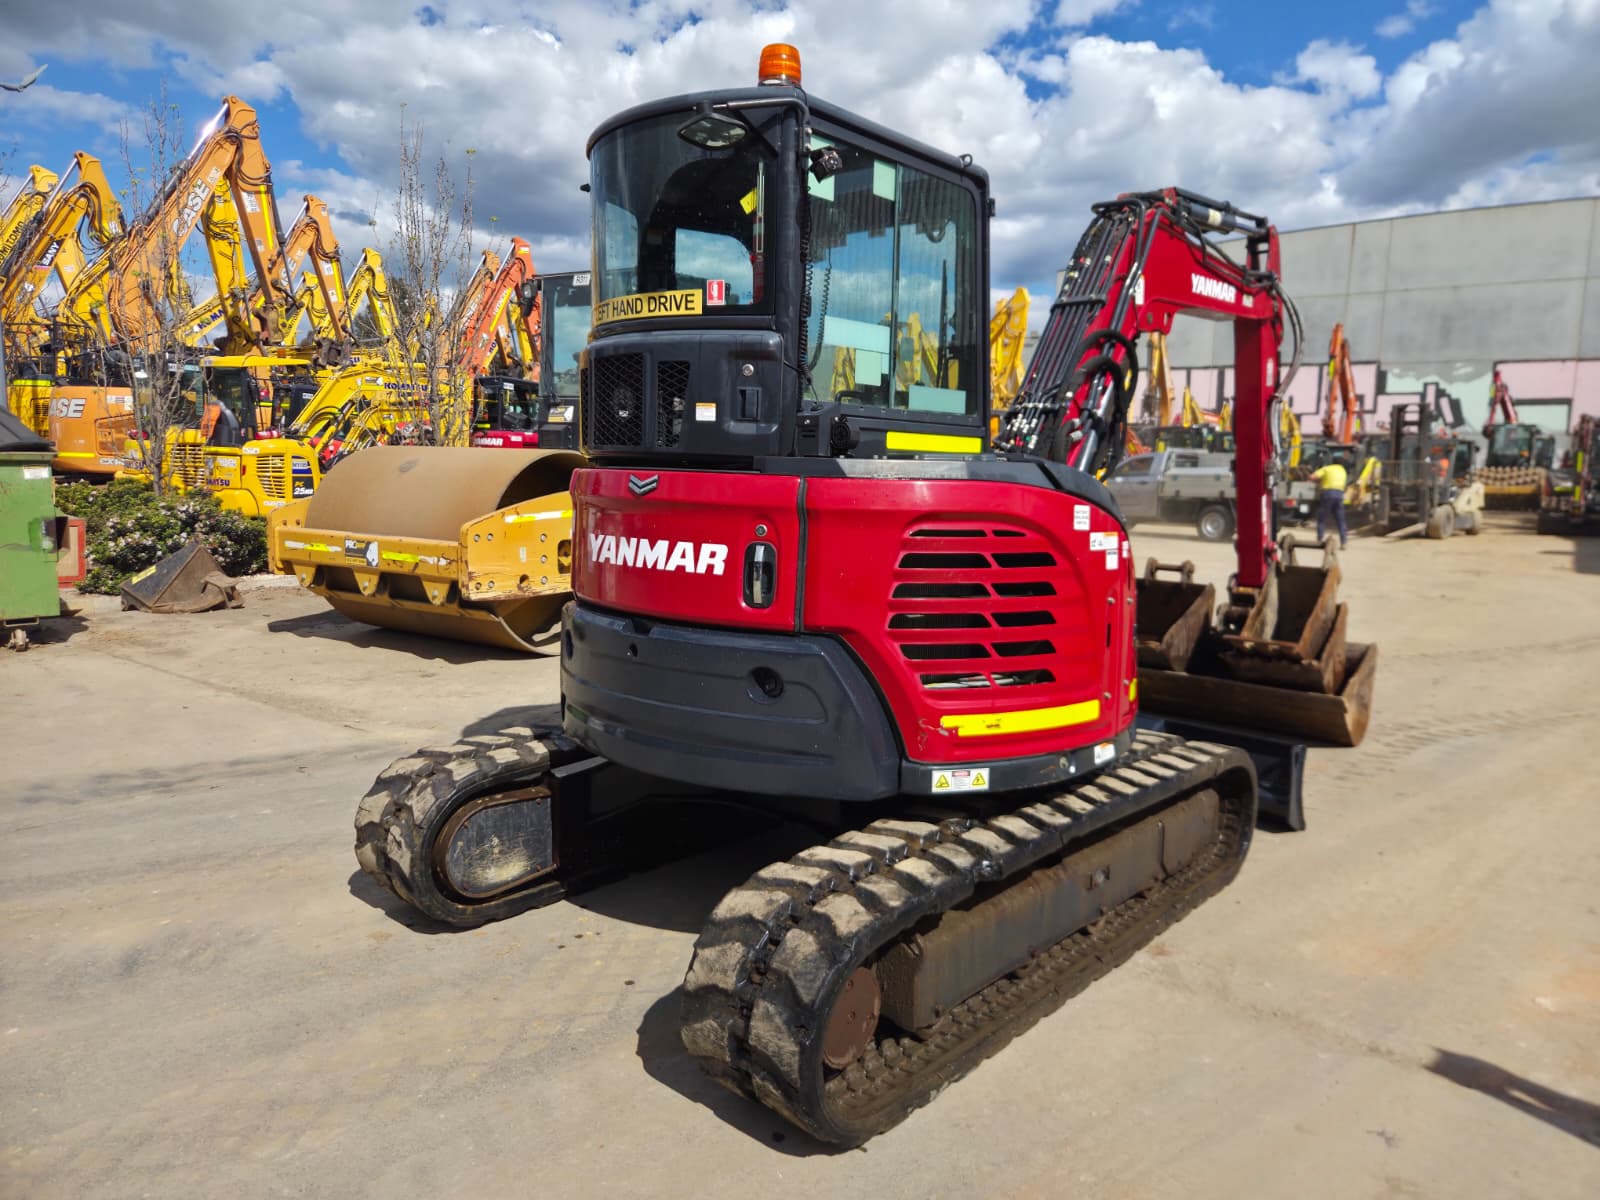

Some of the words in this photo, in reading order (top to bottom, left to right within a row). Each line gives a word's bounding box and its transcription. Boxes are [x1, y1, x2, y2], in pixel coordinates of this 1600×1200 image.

[173, 178, 210, 237] CASE
[41, 241, 60, 266] SANY
[1191, 273, 1237, 304] YANMAR
[612, 297, 643, 317] HAND
[647, 293, 695, 313] DRIVE
[48, 397, 87, 418] ASE
[589, 532, 729, 577] YANMAR
